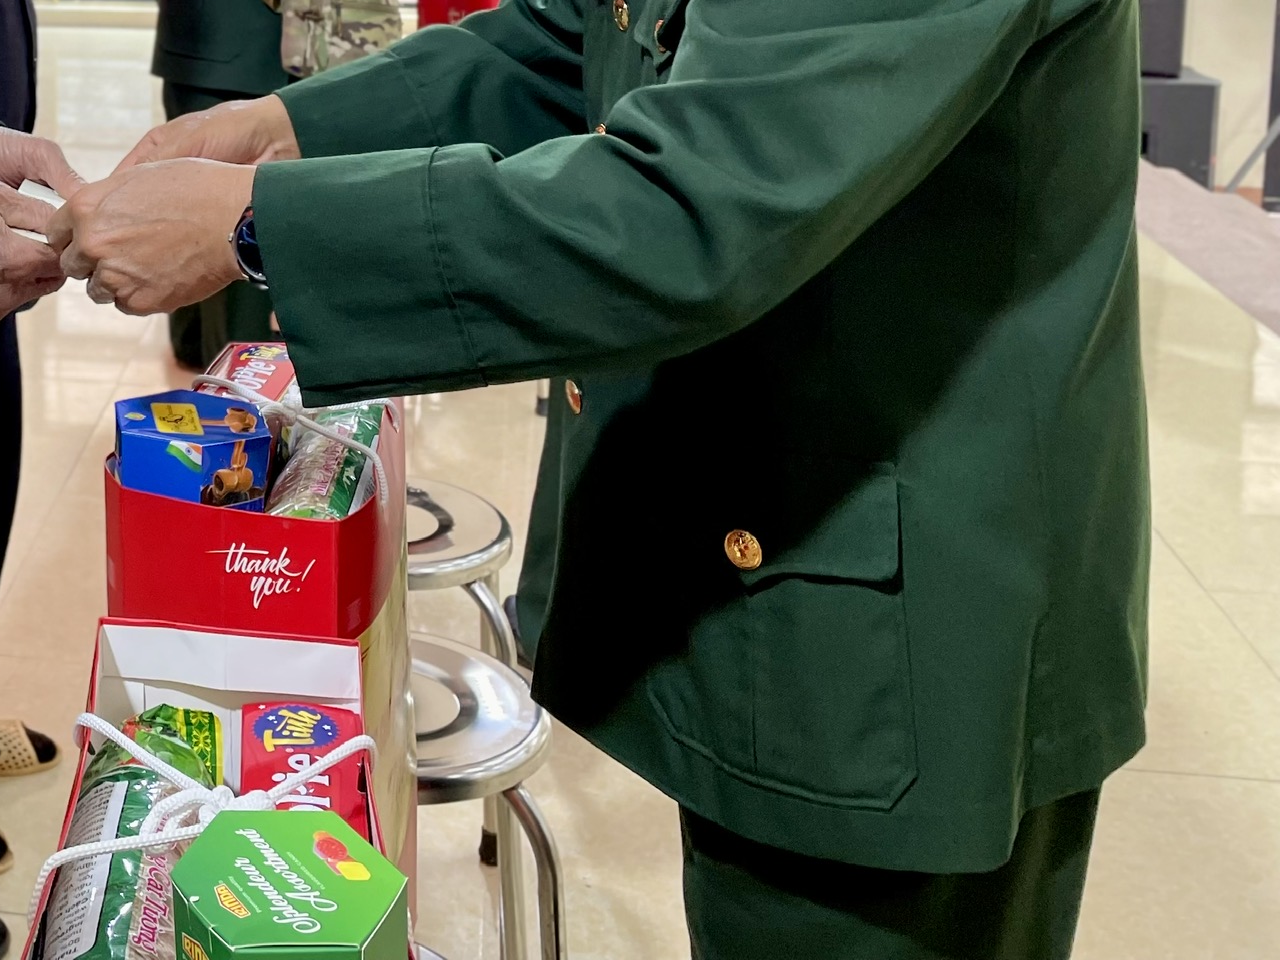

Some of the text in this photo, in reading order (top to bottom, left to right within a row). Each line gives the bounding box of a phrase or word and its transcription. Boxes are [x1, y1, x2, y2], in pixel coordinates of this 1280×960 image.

[204, 542, 302, 577] thank
[250, 558, 316, 610] you!
[234, 828, 338, 912] Assortment
[234, 856, 322, 934] Splendeur
[216, 883, 250, 917] RINDA
